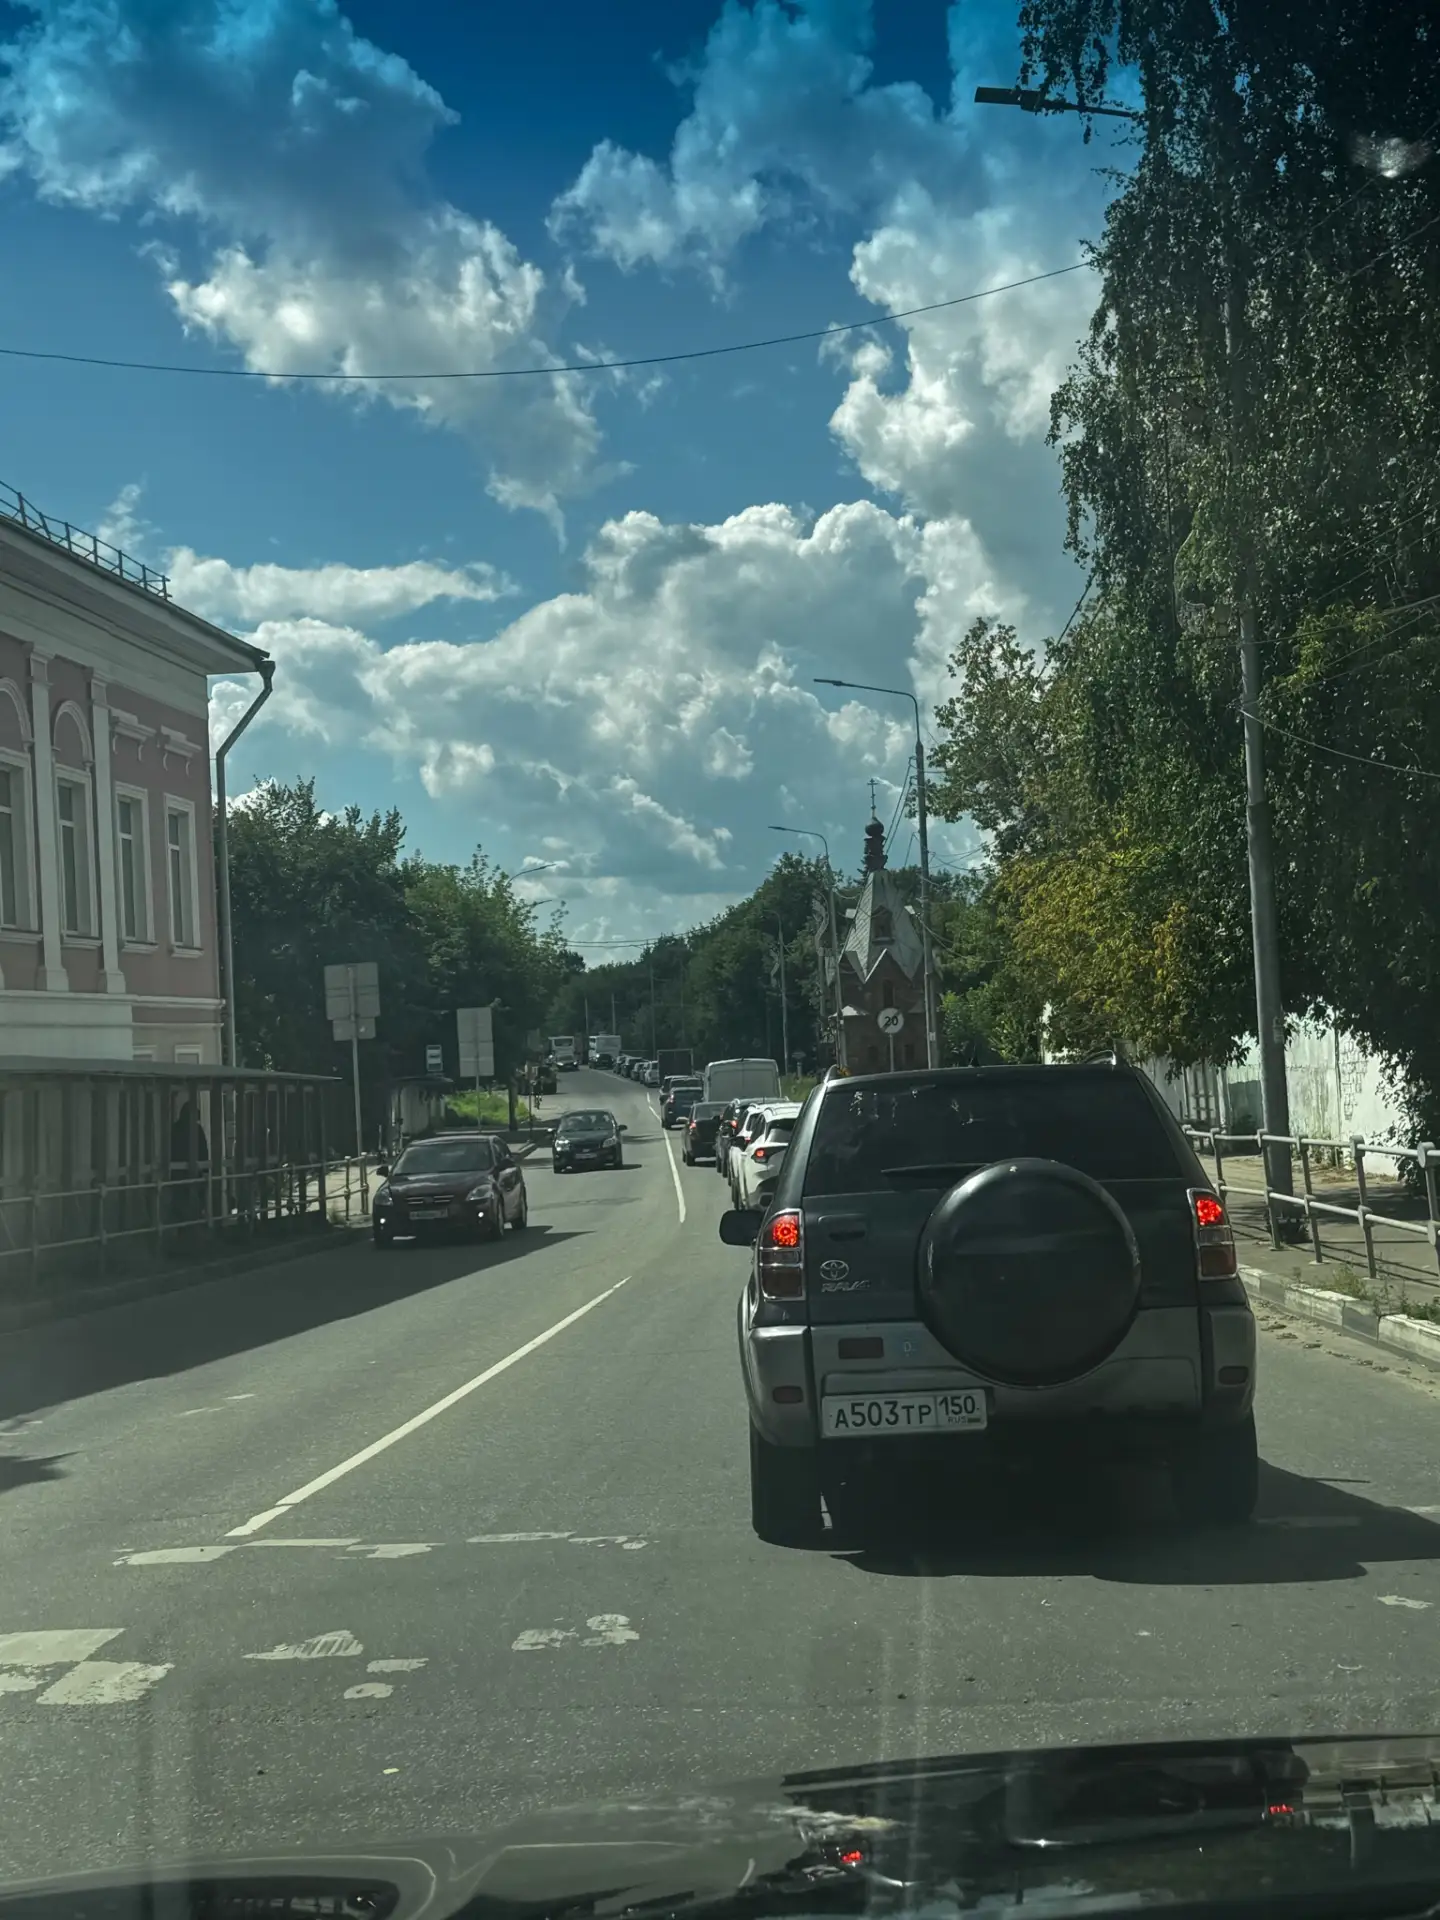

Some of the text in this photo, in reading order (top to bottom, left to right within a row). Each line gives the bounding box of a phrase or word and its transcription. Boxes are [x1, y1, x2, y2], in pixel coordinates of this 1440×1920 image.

[884, 1016, 898, 1026] 20
[834, 1395, 976, 1429] А503ТР 150
